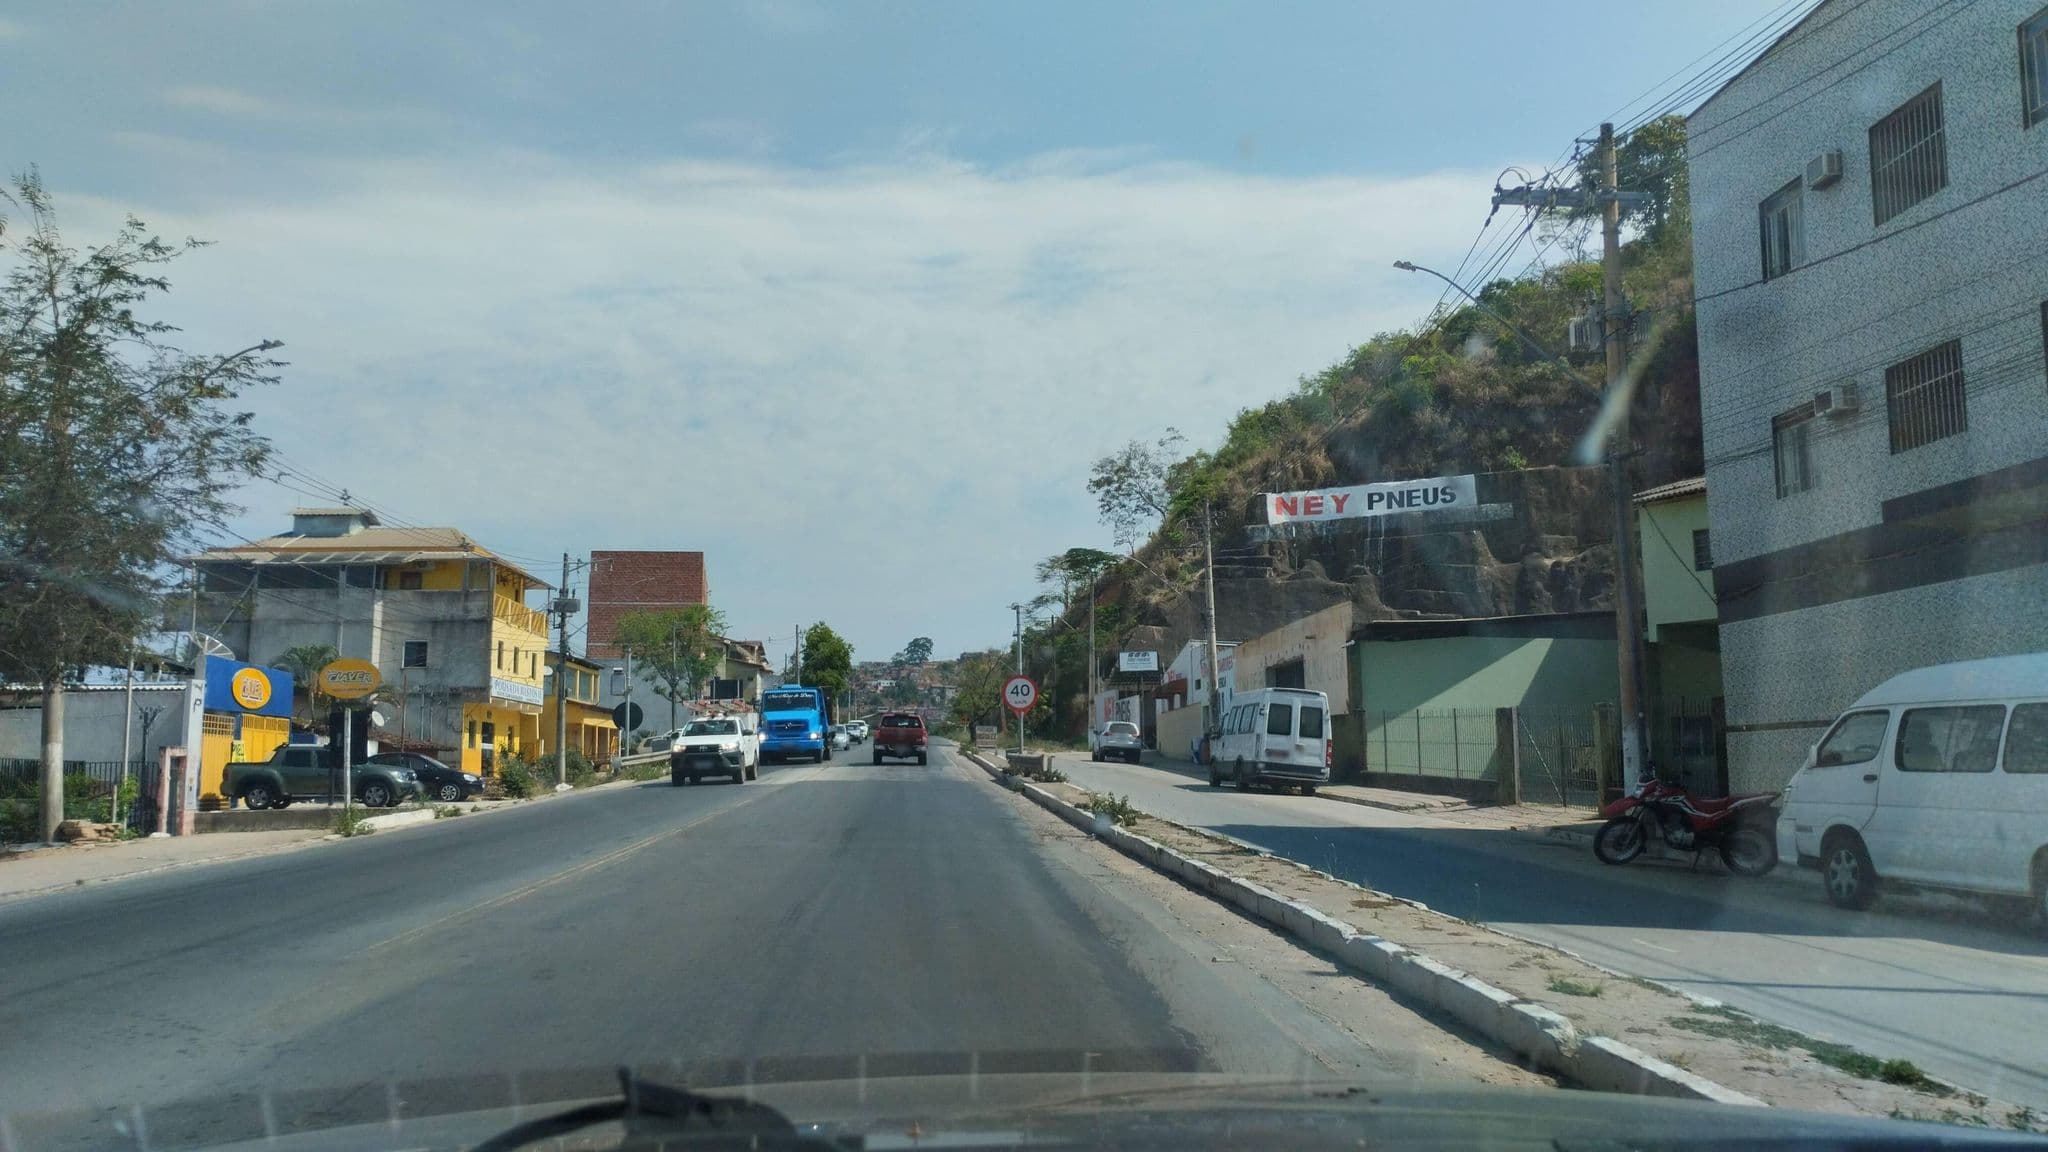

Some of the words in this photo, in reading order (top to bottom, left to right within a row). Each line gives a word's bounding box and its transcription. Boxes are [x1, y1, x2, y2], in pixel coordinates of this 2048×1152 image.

[1275, 493, 1350, 517] NEY
[1367, 486, 1457, 511] PNEUS
[1010, 684, 1030, 697] 40
